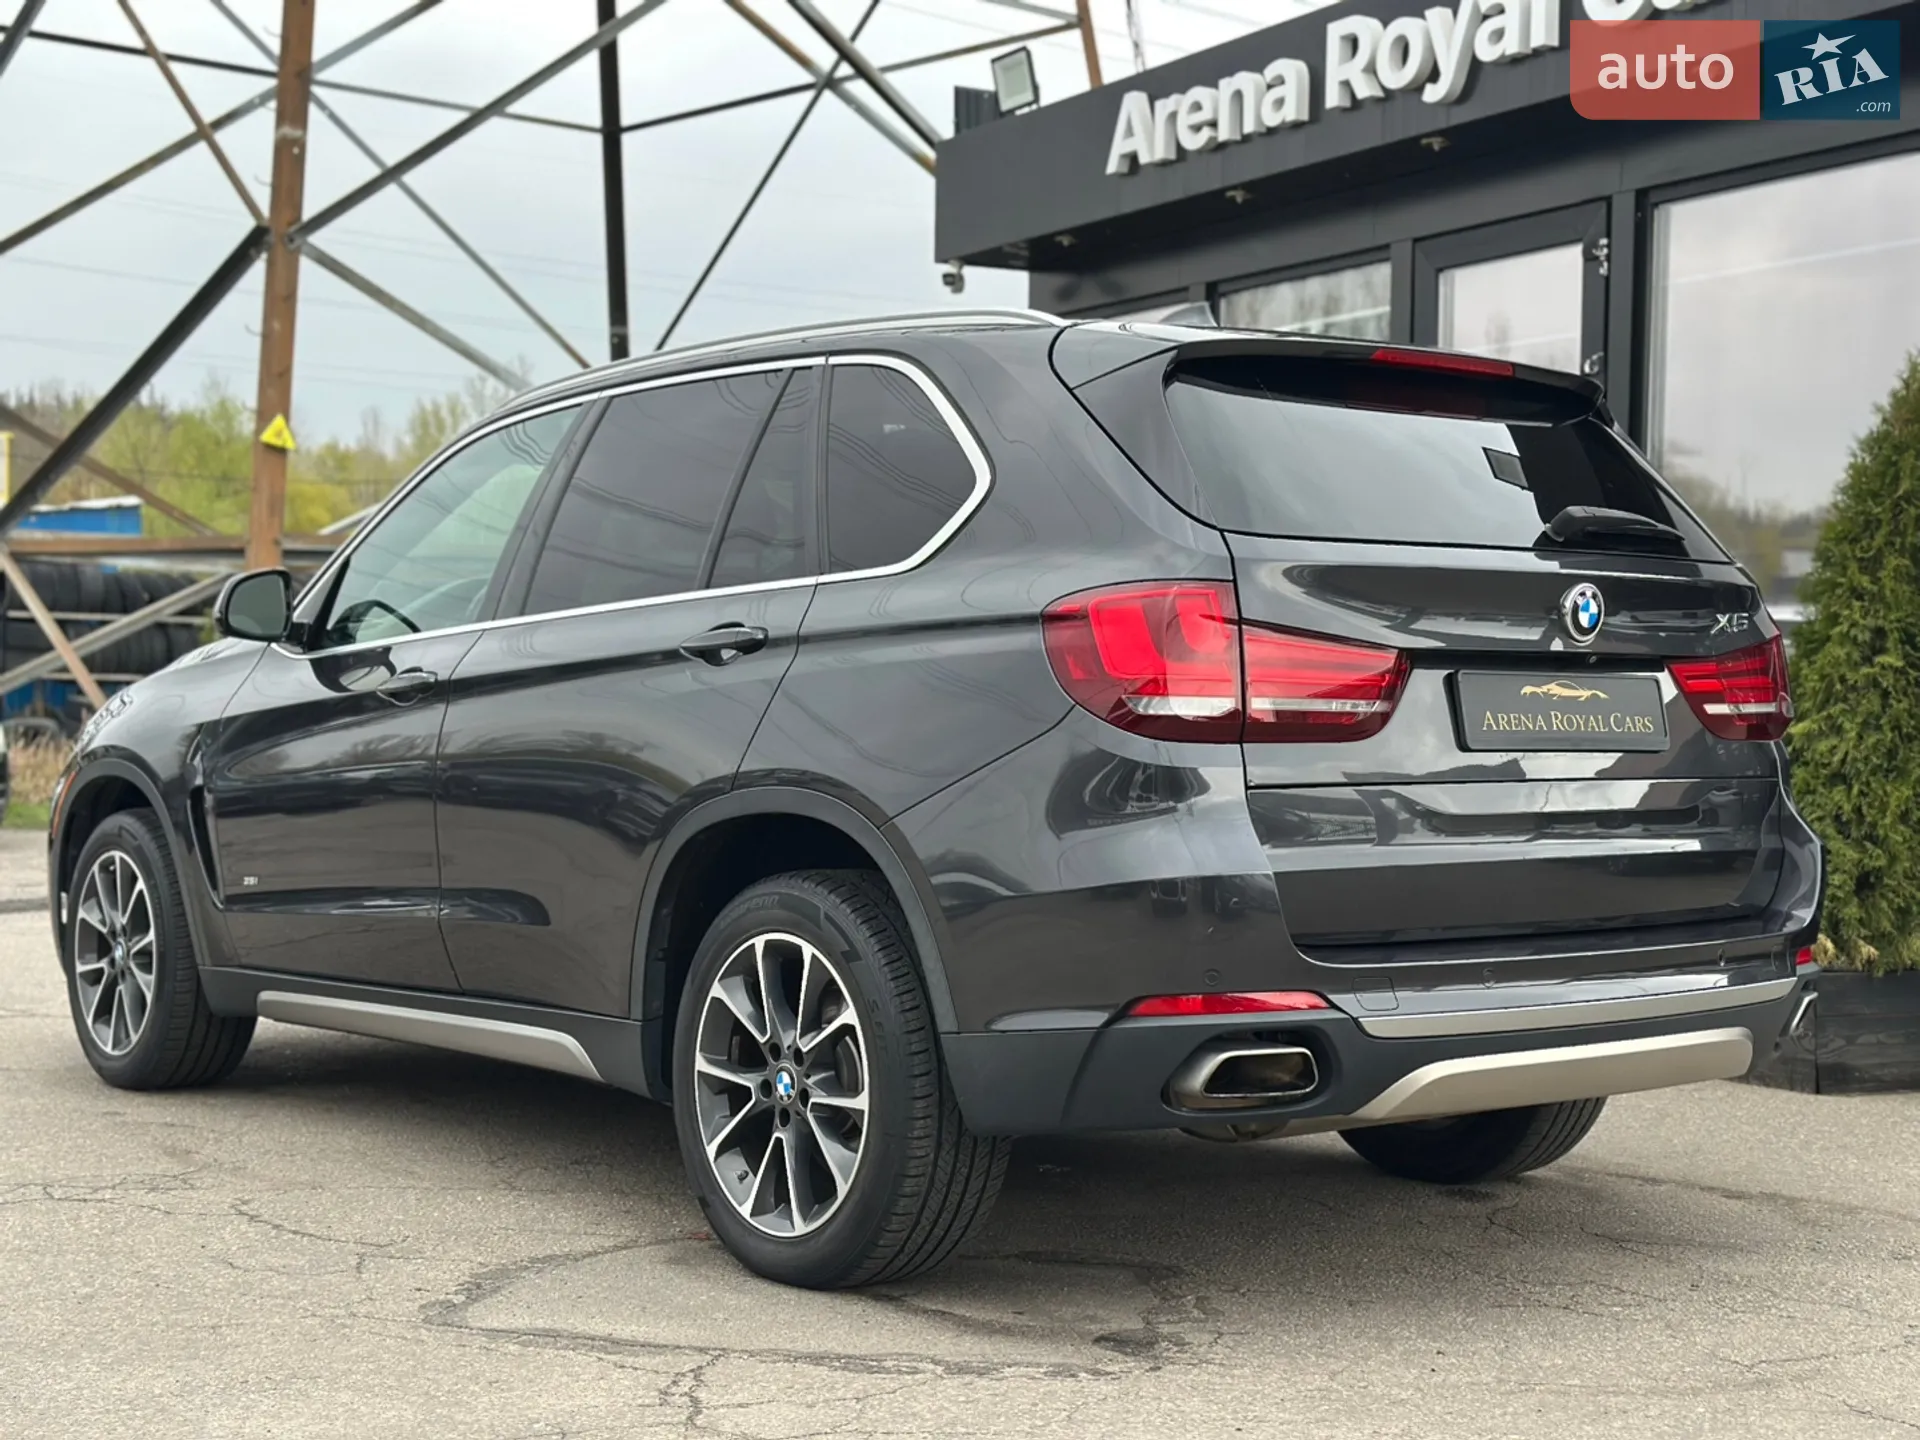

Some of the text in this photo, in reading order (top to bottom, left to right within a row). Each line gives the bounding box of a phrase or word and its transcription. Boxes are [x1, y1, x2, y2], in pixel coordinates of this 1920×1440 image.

[1105, 57, 1310, 175] Arena
[1710, 613, 1749, 634] X5
[1482, 710, 1654, 733] ARENA ROYAL CARS
